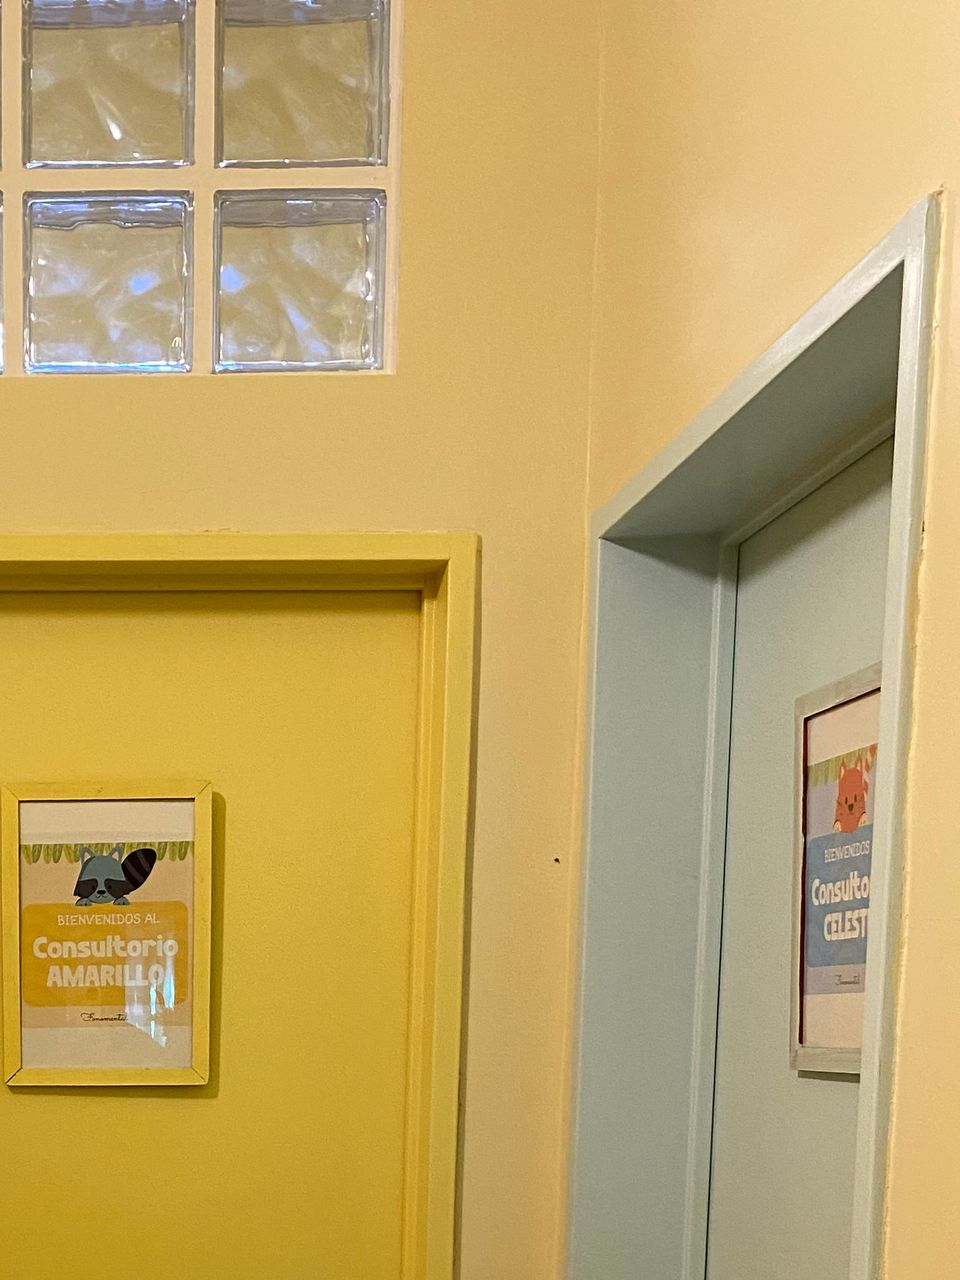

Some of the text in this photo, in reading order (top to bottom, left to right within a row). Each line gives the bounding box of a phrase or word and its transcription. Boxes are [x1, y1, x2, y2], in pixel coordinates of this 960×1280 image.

[824, 840, 870, 862] BIENVENIDOS
[812, 871, 871, 906] Consulto
[57, 913, 160, 926] BIENVENIDOS AL
[33, 935, 178, 958] Consultorio
[46, 964, 165, 987] AMARILLO
